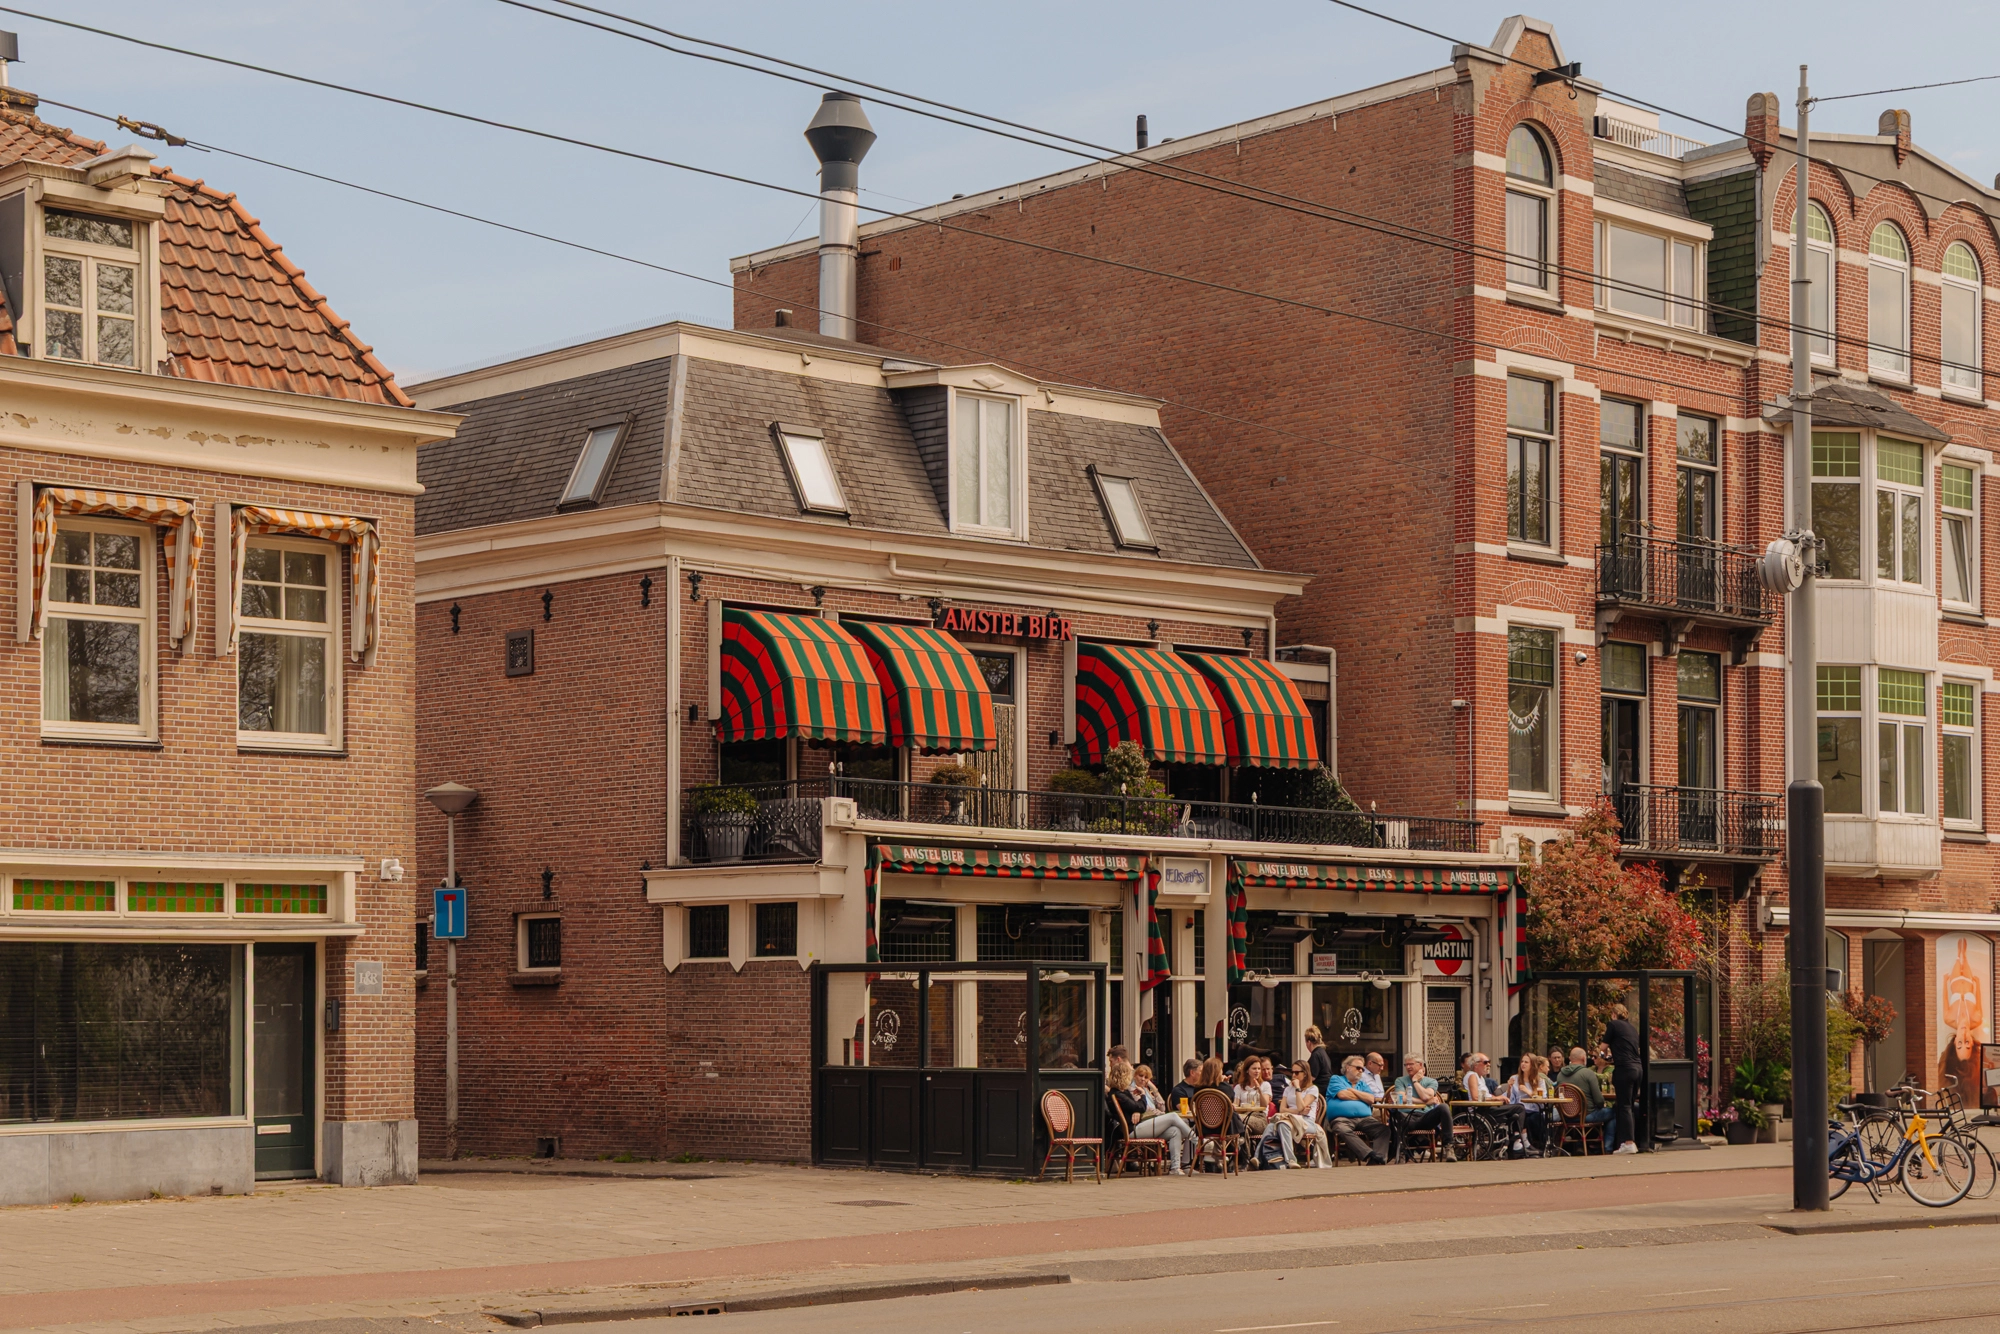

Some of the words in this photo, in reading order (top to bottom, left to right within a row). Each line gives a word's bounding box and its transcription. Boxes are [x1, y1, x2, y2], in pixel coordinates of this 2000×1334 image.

[942, 608, 1023, 636] AMSTEL
[1028, 615, 1073, 641] BIER
[903, 848, 940, 861] AMSTEL
[941, 850, 964, 862] BIER
[1002, 852, 1031, 864] ELSA'S
[1070, 855, 1105, 867] AMSTEL
[1106, 856, 1128, 868] BIER
[1259, 864, 1289, 875] AMSTEL
[1291, 865, 1309, 876] BIER
[1368, 868, 1392, 879] ELSA'S
[1450, 871, 1478, 882] AMSTEL
[1479, 872, 1497, 882] BIER
[1424, 942, 1472, 958] MARTINI
[358, 970, 378, 985] H&R
